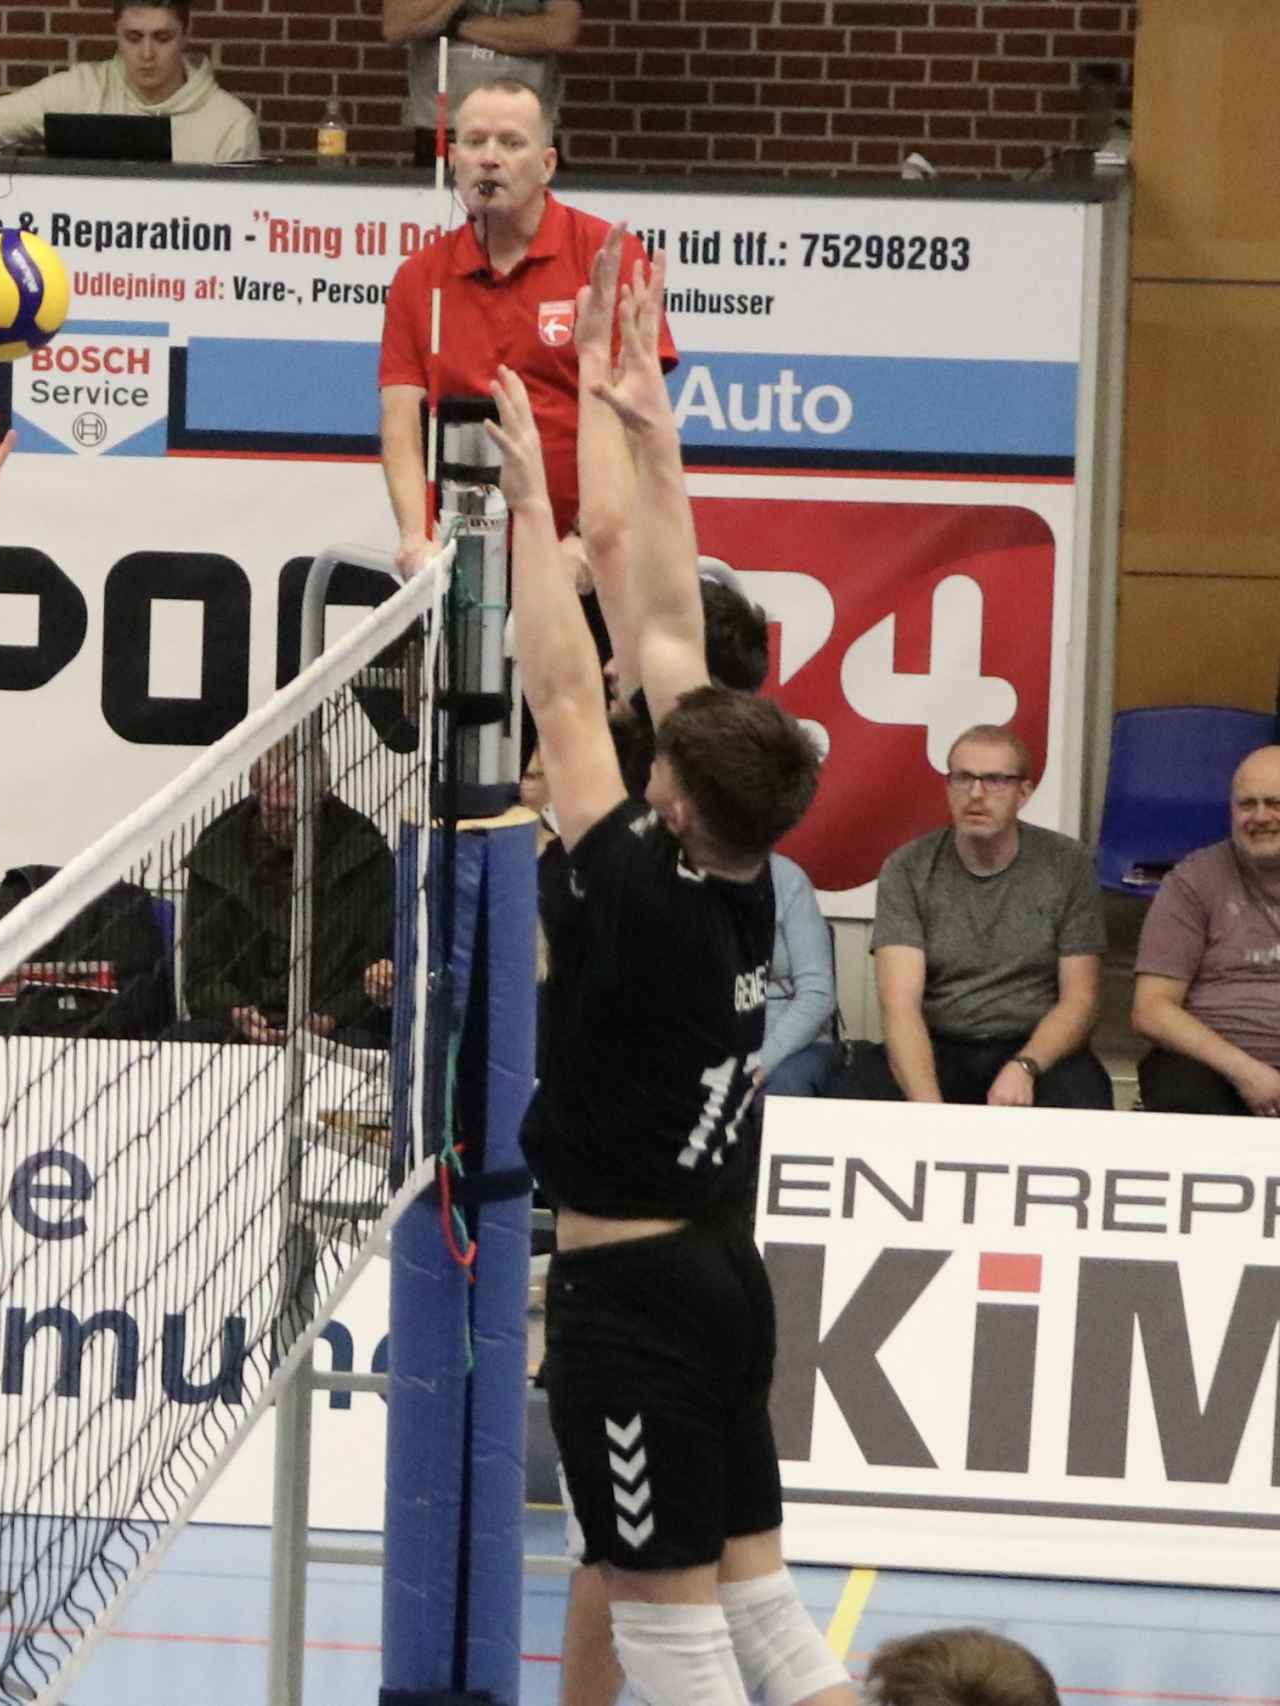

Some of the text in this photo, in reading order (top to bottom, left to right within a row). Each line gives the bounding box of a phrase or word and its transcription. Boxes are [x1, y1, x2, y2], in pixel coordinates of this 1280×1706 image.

[51, 212, 232, 252] Reparation
[355, 221, 388, 256] til
[678, 230, 721, 265] tid
[732, 230, 788, 267] tlf.:
[799, 232, 972, 272] 75298283
[72, 271, 186, 301] Udlejning
[194, 274, 225, 301] af:
[662, 288, 775, 316] inibusser
[32, 345, 151, 376] BOSCH
[30, 379, 150, 408] Service
[672, 364, 854, 435] Auto
[765, 1153, 1280, 1239] ENTREP
